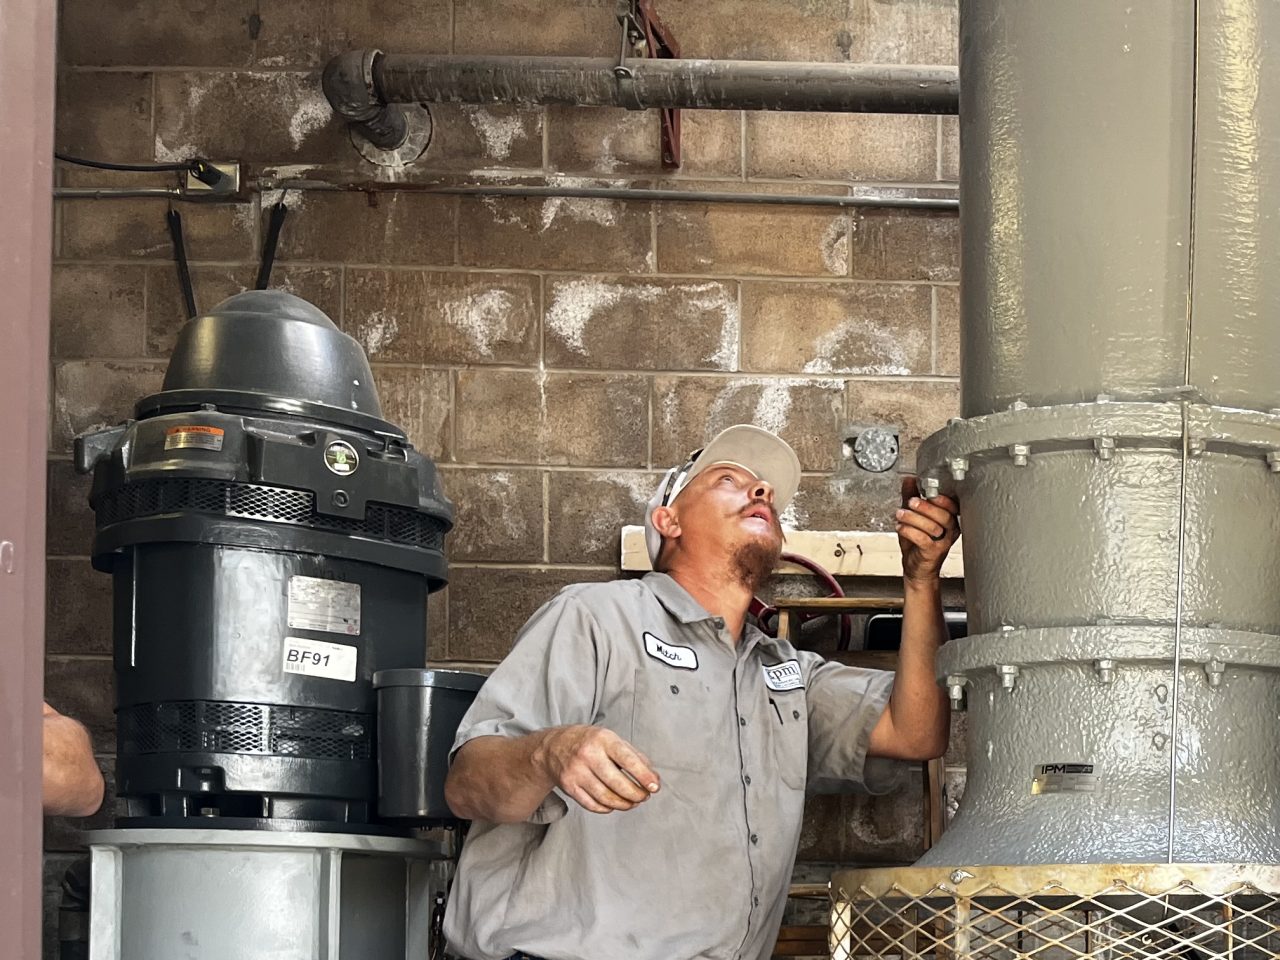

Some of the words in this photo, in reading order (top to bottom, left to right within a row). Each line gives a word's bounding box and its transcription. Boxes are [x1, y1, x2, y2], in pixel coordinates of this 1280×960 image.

[286, 649, 331, 667] BF91
[656, 643, 682, 661] Mitch
[1041, 764, 1066, 775] IPM
